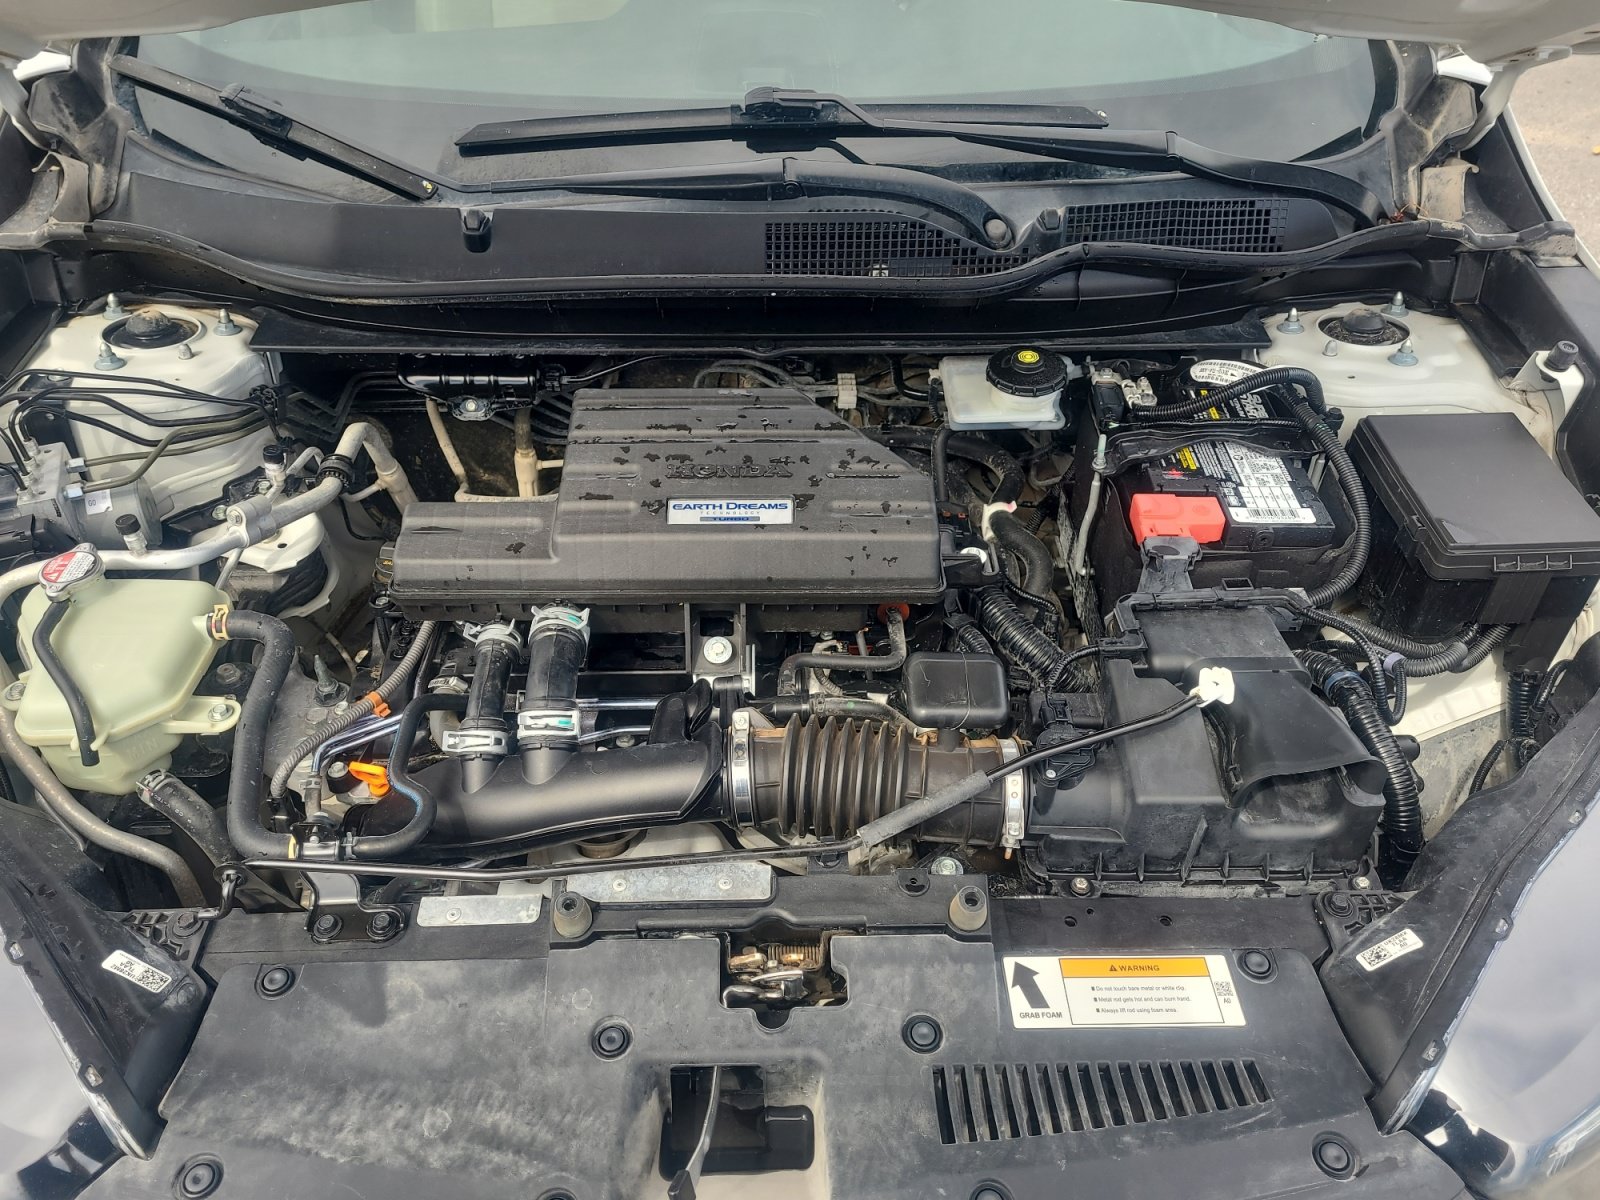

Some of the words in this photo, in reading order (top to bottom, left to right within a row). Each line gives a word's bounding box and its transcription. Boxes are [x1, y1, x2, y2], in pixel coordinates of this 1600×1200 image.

[665, 463, 793, 479] HONDA
[726, 502, 788, 510] DREAMS
[1119, 964, 1160, 972] WARNING
